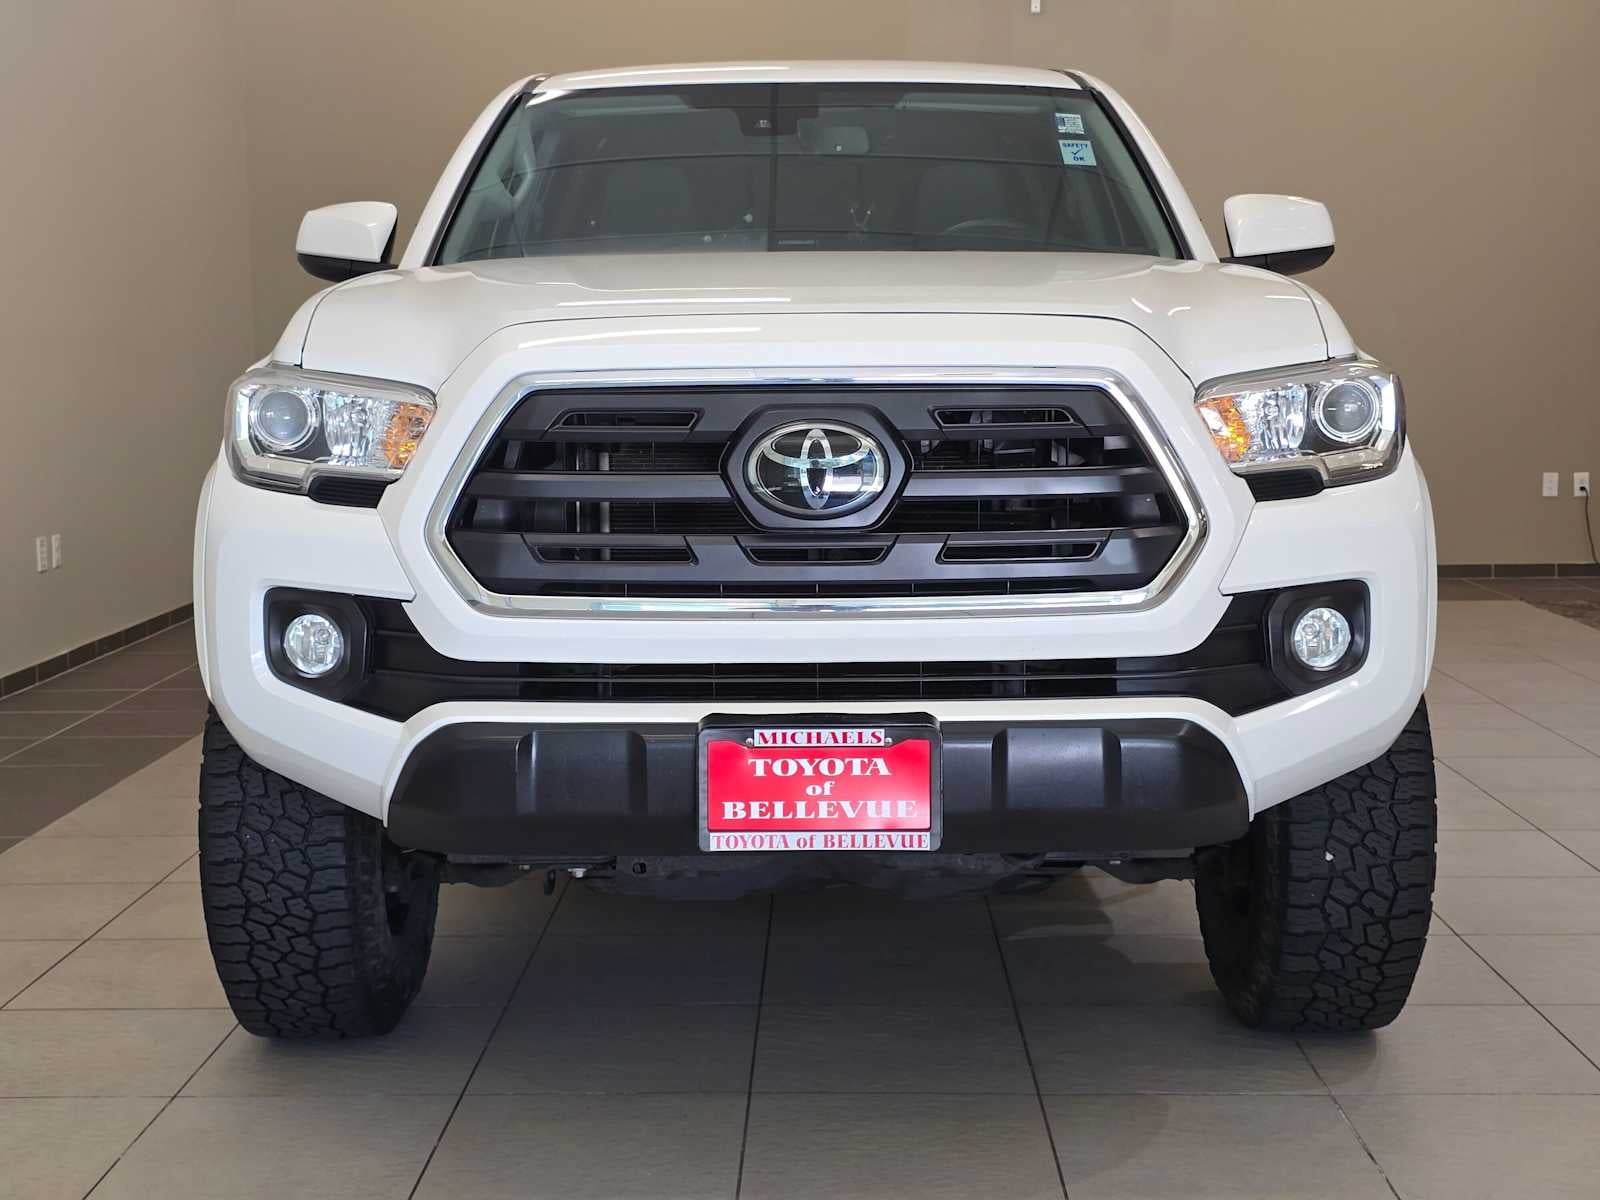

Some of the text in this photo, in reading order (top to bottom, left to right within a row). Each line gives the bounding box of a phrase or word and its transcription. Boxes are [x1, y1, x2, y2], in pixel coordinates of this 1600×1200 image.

[758, 731, 882, 745] MICHAELS
[748, 758, 891, 776] TOYOTA
[806, 781, 835, 796] of
[722, 801, 917, 819] BELLEVUE
[712, 834, 929, 849] TOYOTA of BELLEVUE
